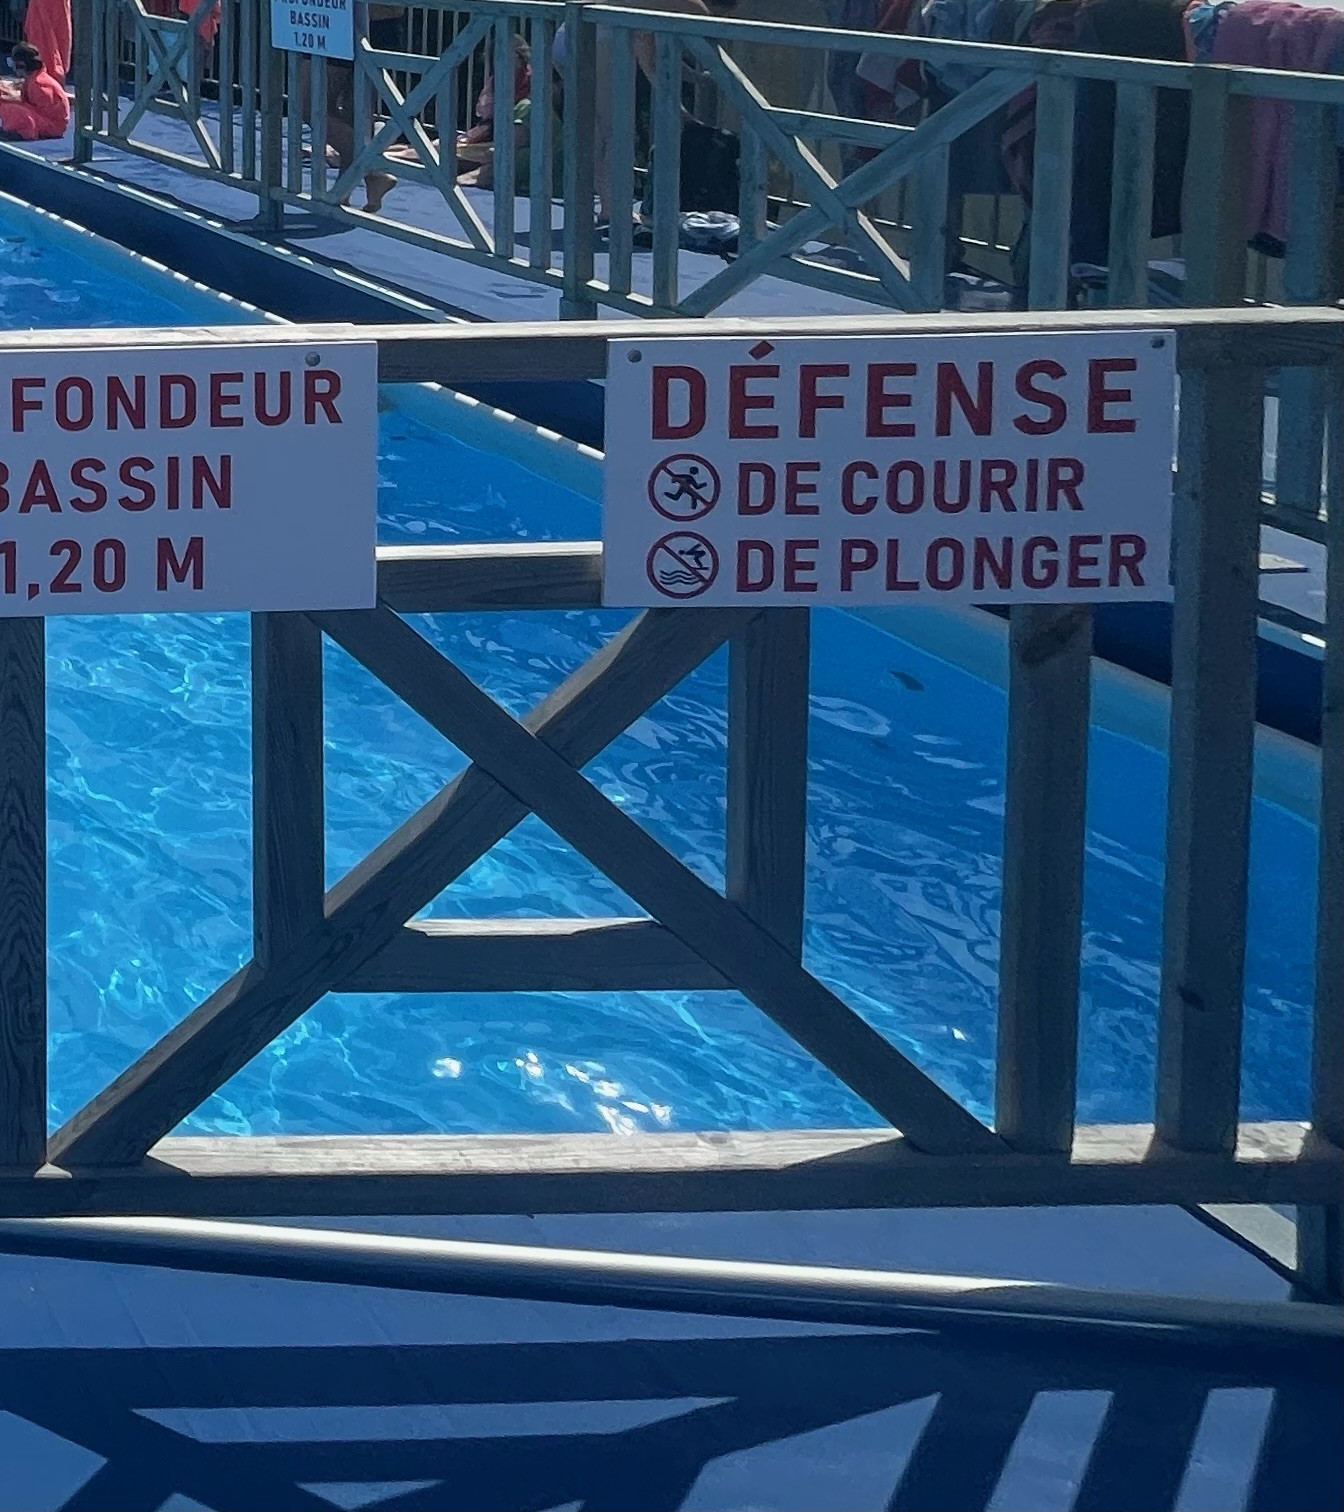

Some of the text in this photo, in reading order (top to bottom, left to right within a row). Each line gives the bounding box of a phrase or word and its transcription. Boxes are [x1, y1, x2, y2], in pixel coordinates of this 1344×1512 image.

[289, 10, 330, 29] BASSIN
[317, 35, 326, 50] M
[651, 340, 1138, 440] DÉFENSE
[737, 457, 1085, 515] DE COURIR
[157, 537, 203, 591] M
[736, 533, 1147, 592] DE PLONGER
